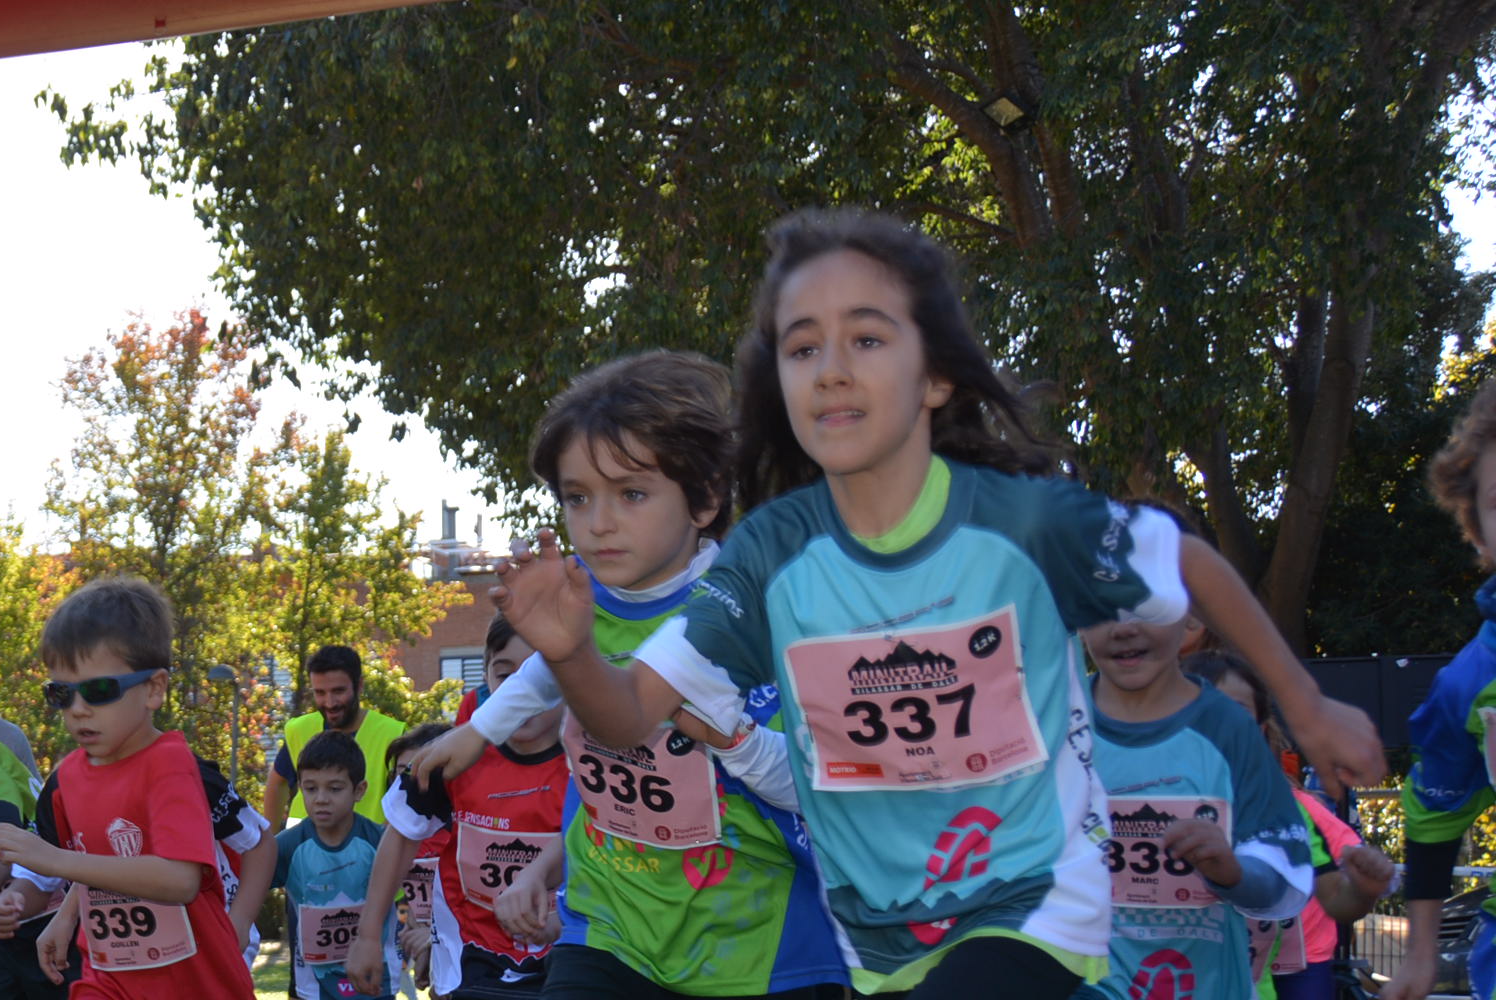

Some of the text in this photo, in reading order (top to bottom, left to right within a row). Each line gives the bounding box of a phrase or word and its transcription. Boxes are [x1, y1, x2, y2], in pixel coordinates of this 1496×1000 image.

[850, 661, 954, 683] MINITRAIL
[844, 683, 976, 746] 337
[905, 745, 935, 757] NOA
[579, 754, 675, 813] 336
[613, 802, 636, 816] ERIC
[1130, 876, 1160, 885] MARC
[88, 905, 157, 941] 339
